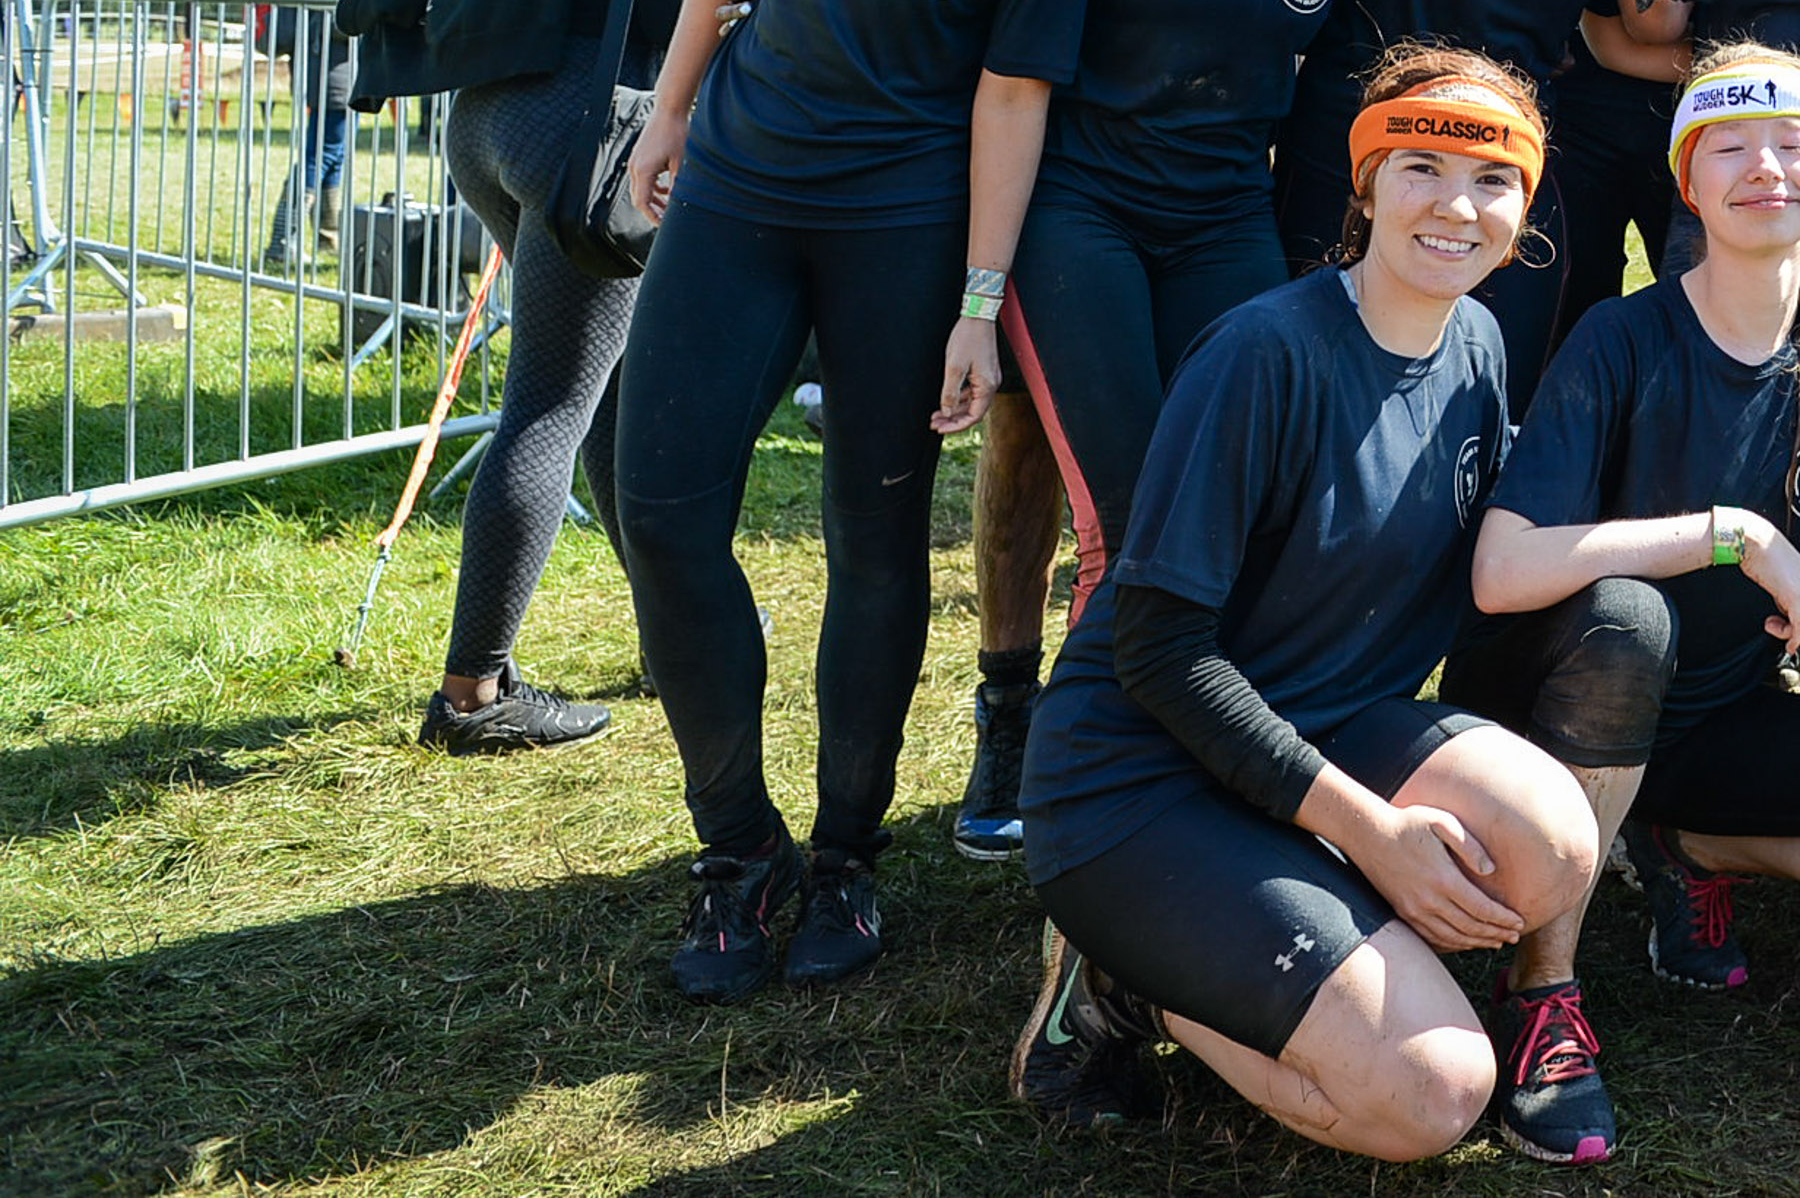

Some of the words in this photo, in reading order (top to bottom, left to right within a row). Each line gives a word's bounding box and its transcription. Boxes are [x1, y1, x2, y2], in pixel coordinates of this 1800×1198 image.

[1693, 88, 1724, 105] TOUGH
[1726, 85, 1767, 106] 5K
[1387, 117, 1413, 127] TOUGH
[1415, 117, 1496, 142] CLASSIC
